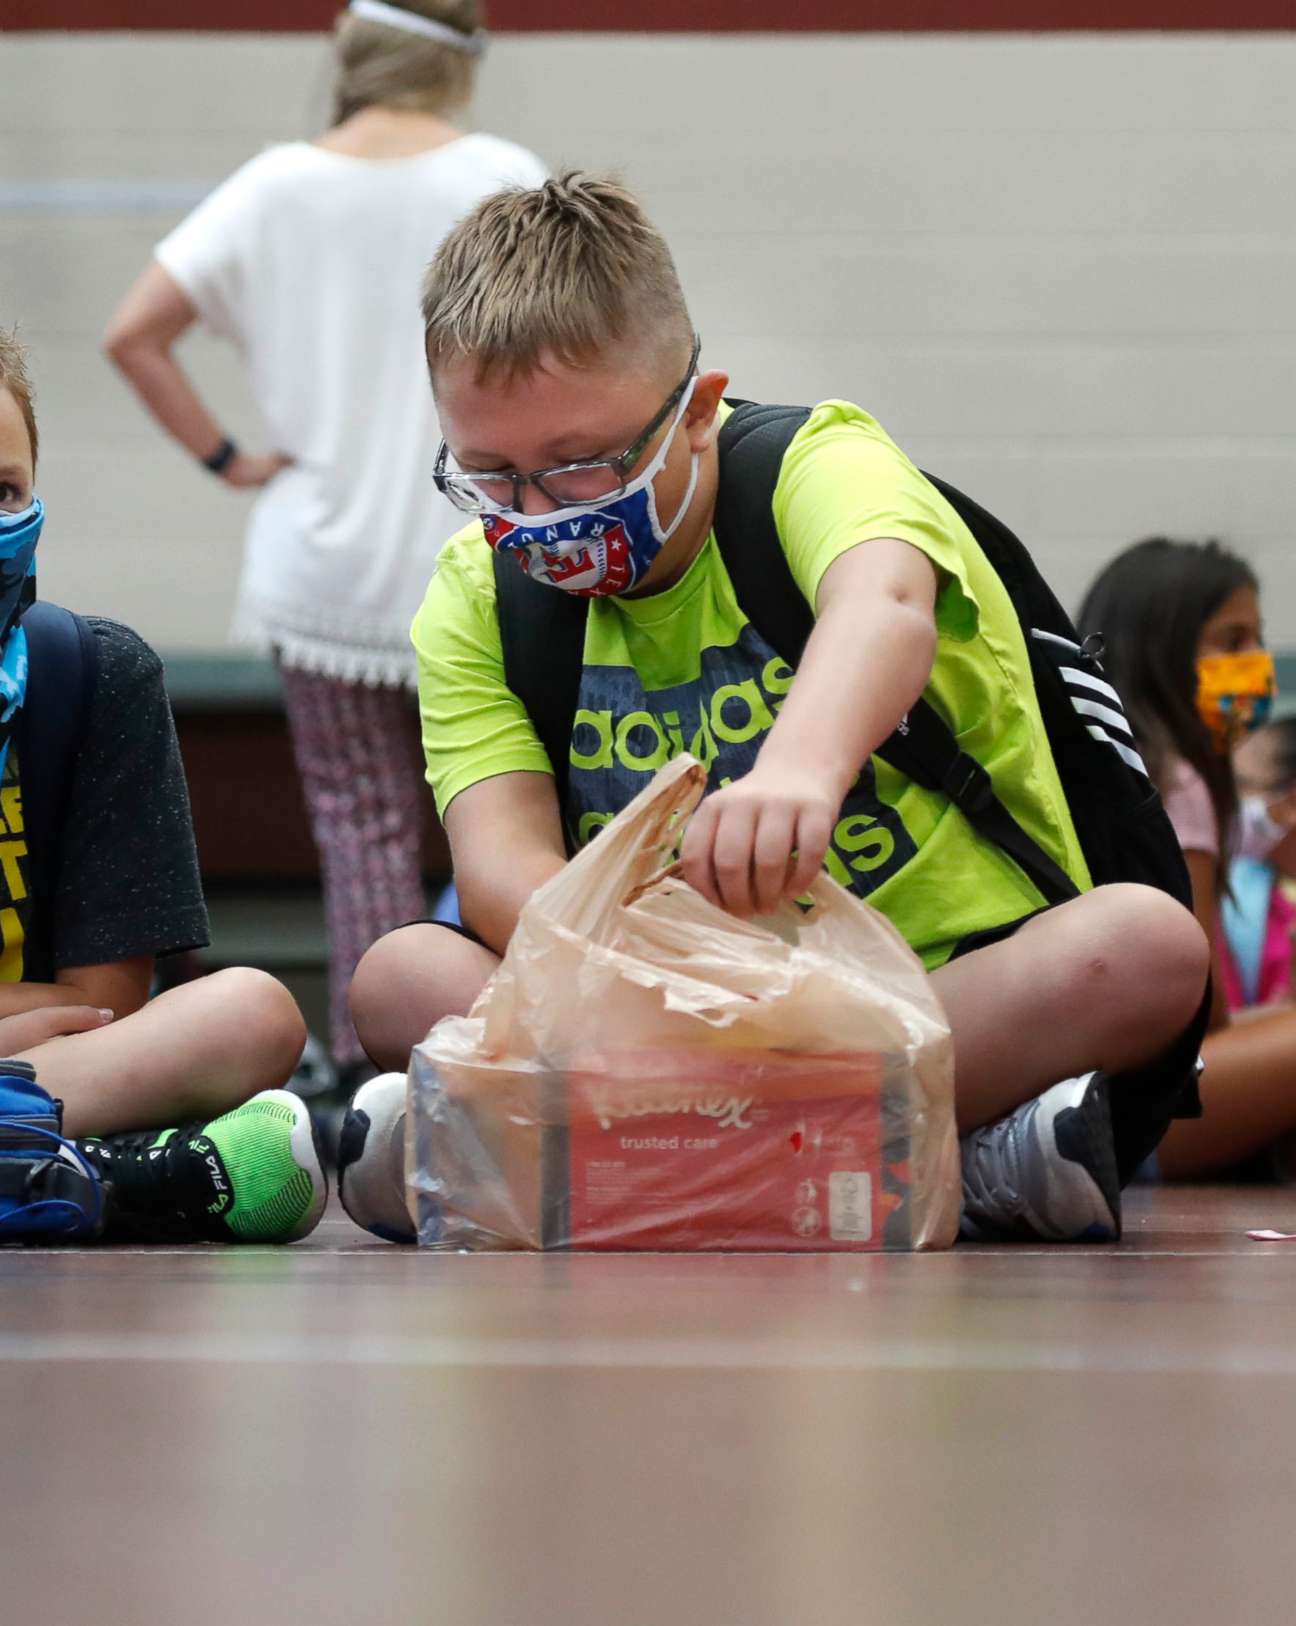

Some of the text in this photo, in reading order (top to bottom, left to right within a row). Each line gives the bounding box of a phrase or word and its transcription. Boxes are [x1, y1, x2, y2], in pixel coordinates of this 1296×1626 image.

[620, 1135, 720, 1150] trusted care
[205, 1155, 228, 1191] FILA
